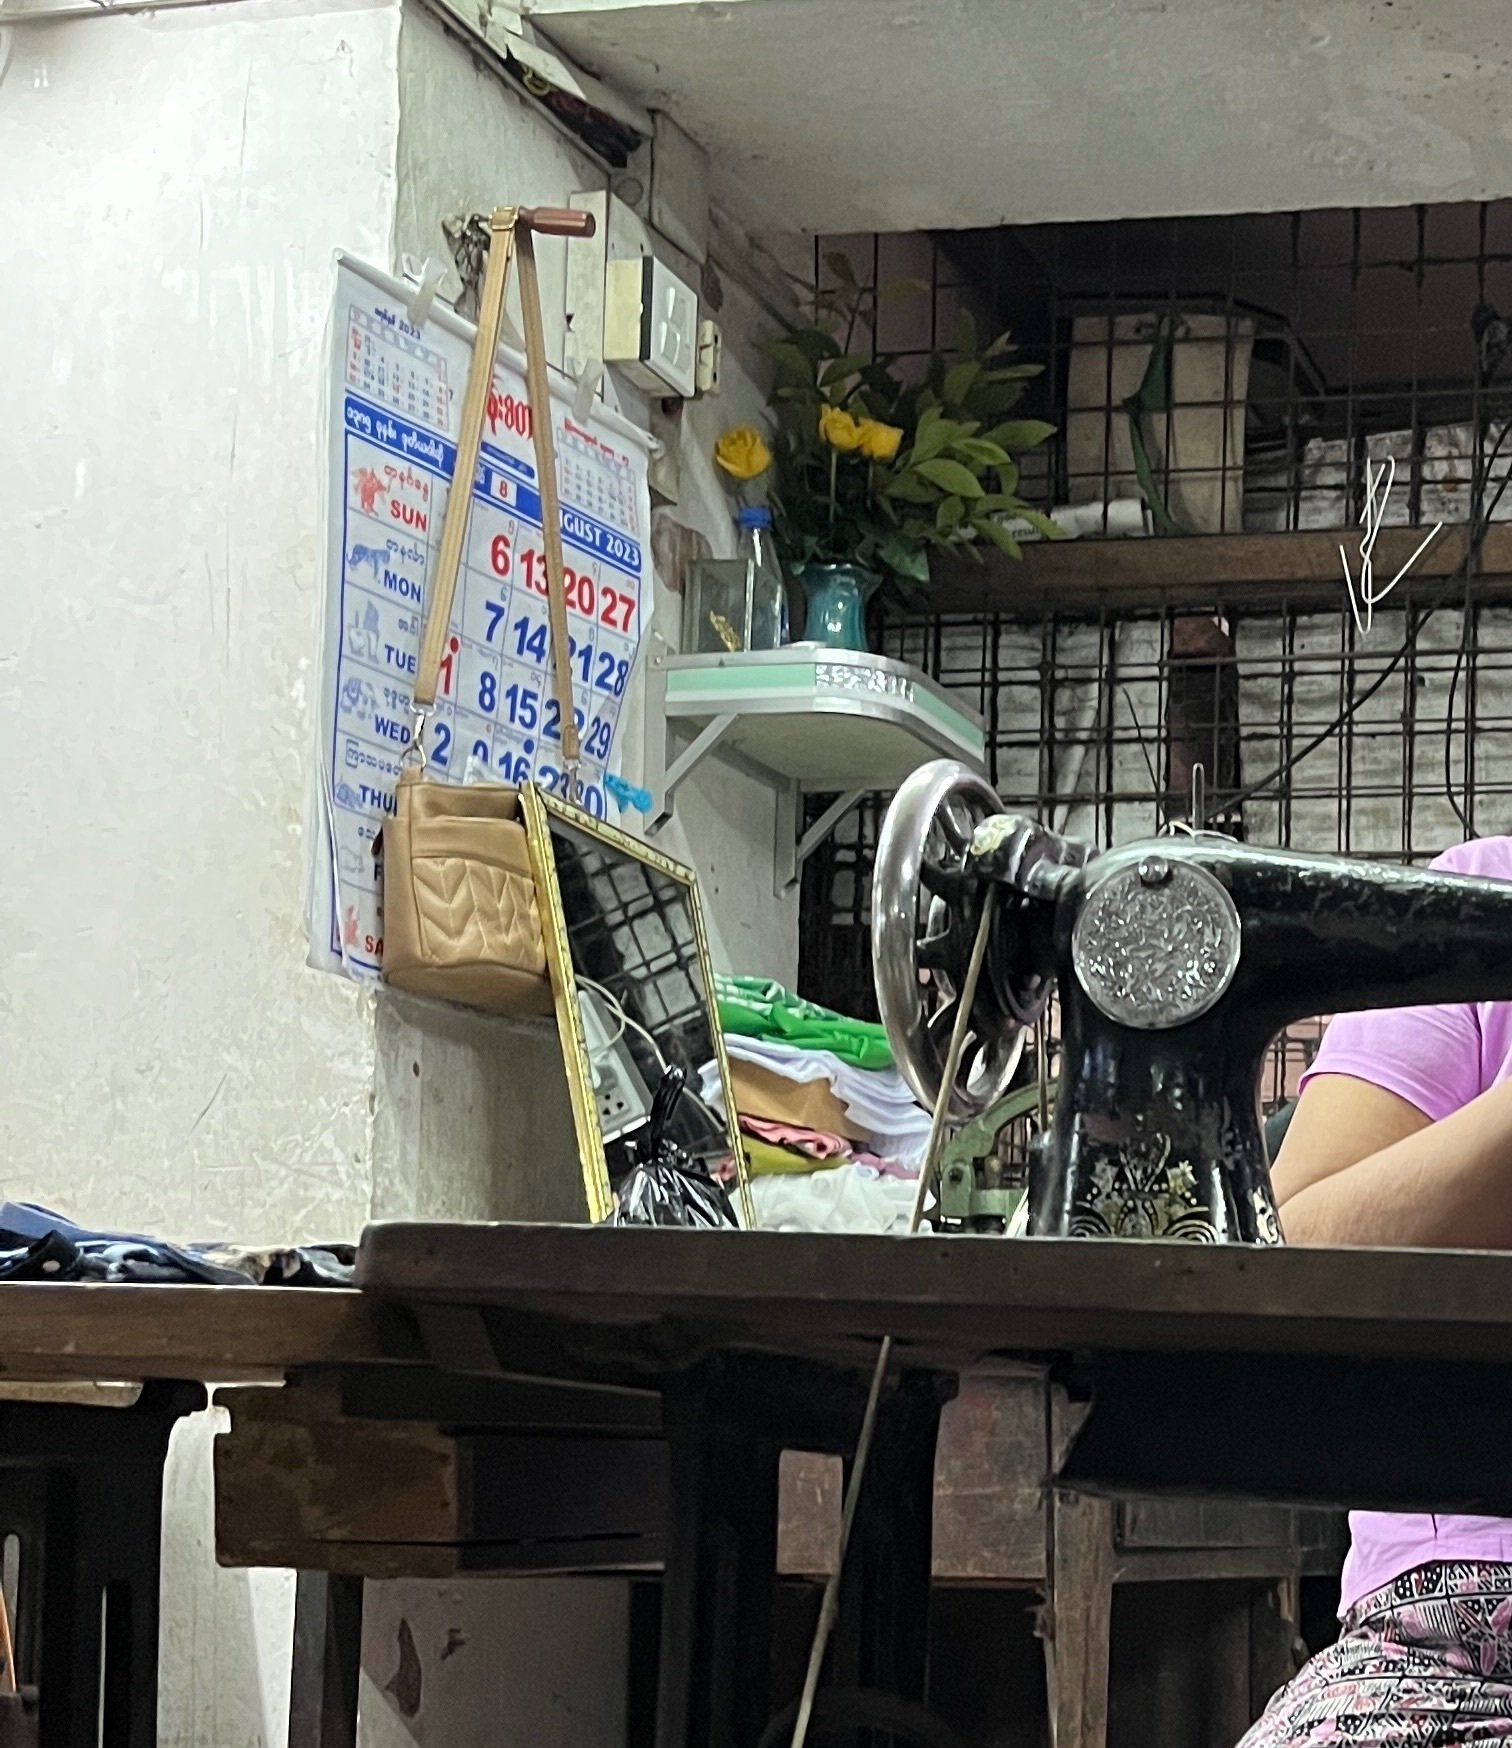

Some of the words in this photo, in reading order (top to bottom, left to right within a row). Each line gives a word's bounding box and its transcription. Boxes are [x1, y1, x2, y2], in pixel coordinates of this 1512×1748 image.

[499, 480, 508, 498] 8
[390, 499, 427, 532] SUN
[559, 508, 602, 547] GUST
[606, 533, 640, 566] 2023
[384, 569, 421, 603] MON
[491, 534, 511, 577] 6
[562, 566, 595, 616] 20
[600, 586, 636, 633] 27
[384, 643, 416, 674] TUE
[486, 600, 505, 643] 7
[513, 615, 548, 664] 14
[594, 651, 629, 697] 28
[440, 653, 453, 696] 1
[478, 671, 497, 713] 8
[505, 683, 539, 729] 15
[584, 715, 612, 760] 29
[374, 714, 411, 744] WED
[431, 722, 451, 767] 2
[498, 750, 531, 785] 16
[365, 934, 384, 958] SA
